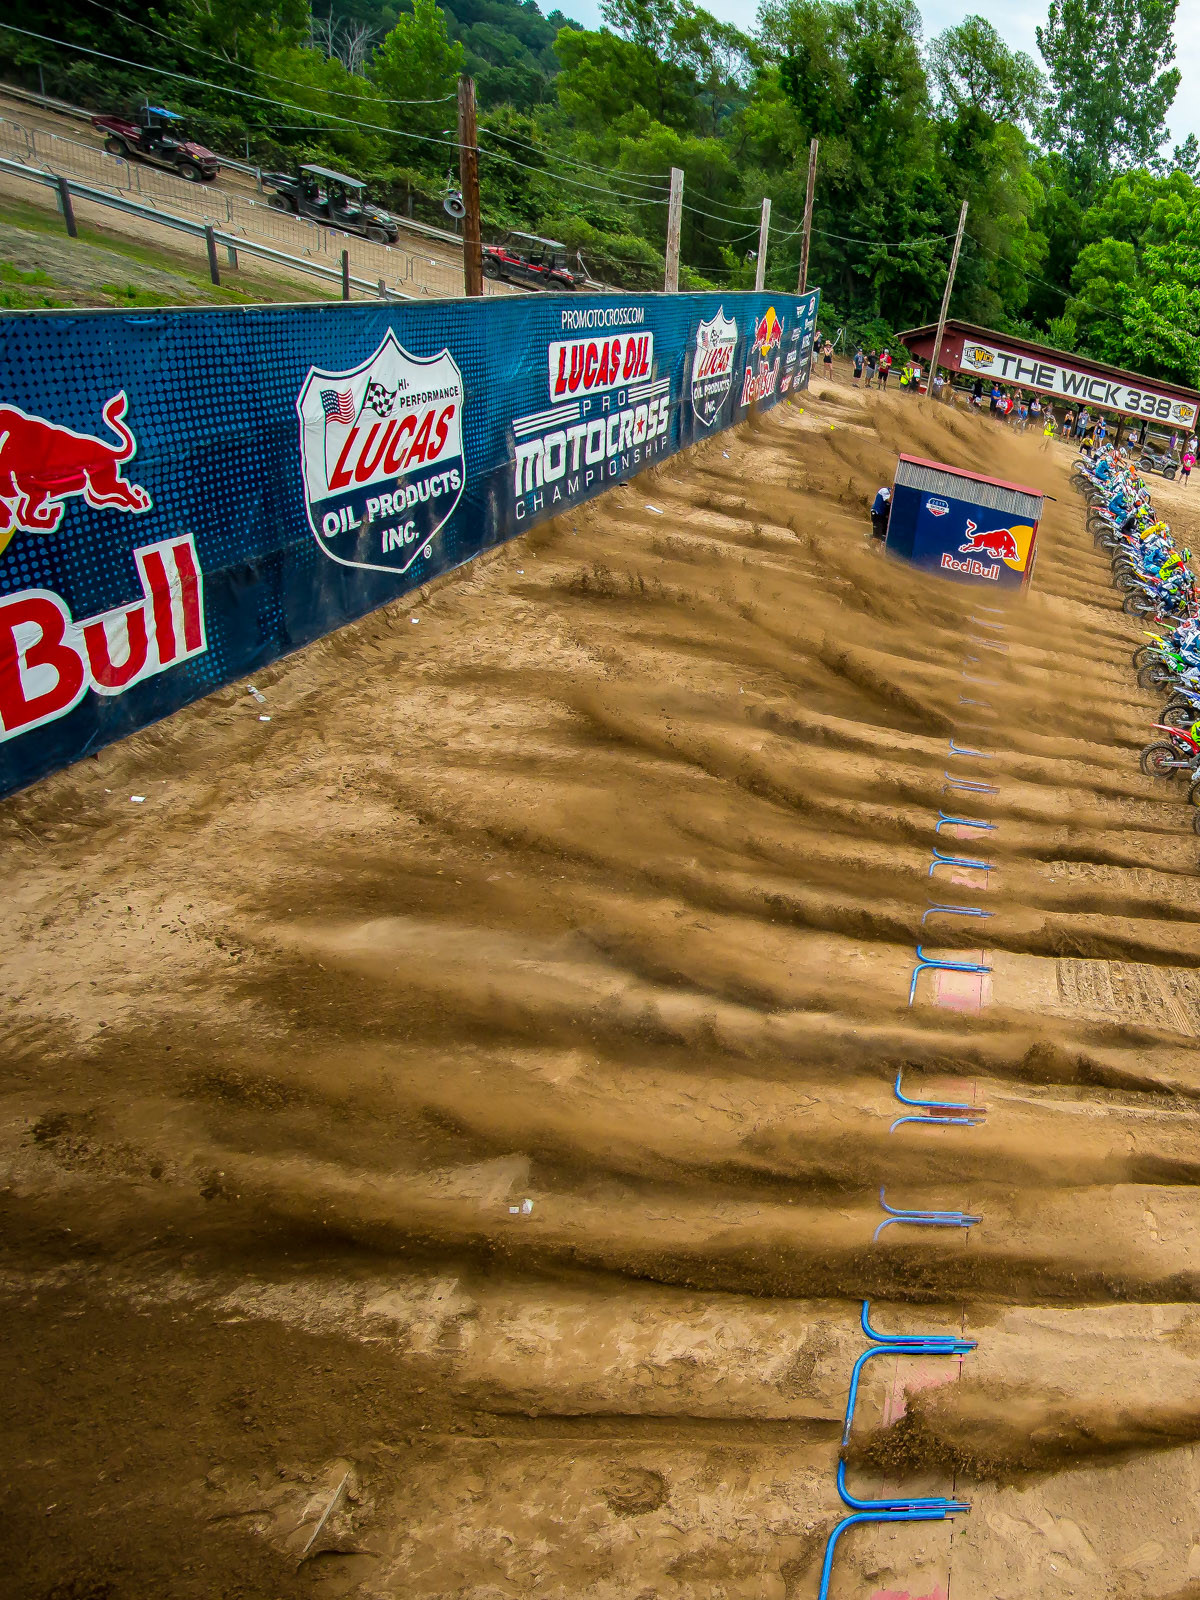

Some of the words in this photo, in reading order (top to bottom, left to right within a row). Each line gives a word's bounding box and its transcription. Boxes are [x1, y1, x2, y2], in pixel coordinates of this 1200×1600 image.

[561, 308, 644, 329] PROMOTOCROSS.COM
[398, 378, 410, 391] HI-
[555, 341, 620, 395] LUCAS
[623, 336, 650, 381] OIL
[698, 346, 733, 378] LUCAS
[997, 352, 1057, 389] THE
[1061, 370, 1122, 406] WICK
[1125, 390, 1172, 419] 338
[400, 386, 459, 408] PERFORMANCE
[583, 390, 626, 417] PRO
[328, 404, 456, 491] LUCAS
[514, 396, 671, 497] MOTOCROSS
[323, 506, 362, 538] OIL
[366, 469, 461, 523] PRODUCTS
[516, 436, 667, 520] CHAMPIONSHIP
[382, 521, 420, 553] INC.
[0, 534, 207, 742] Bull
